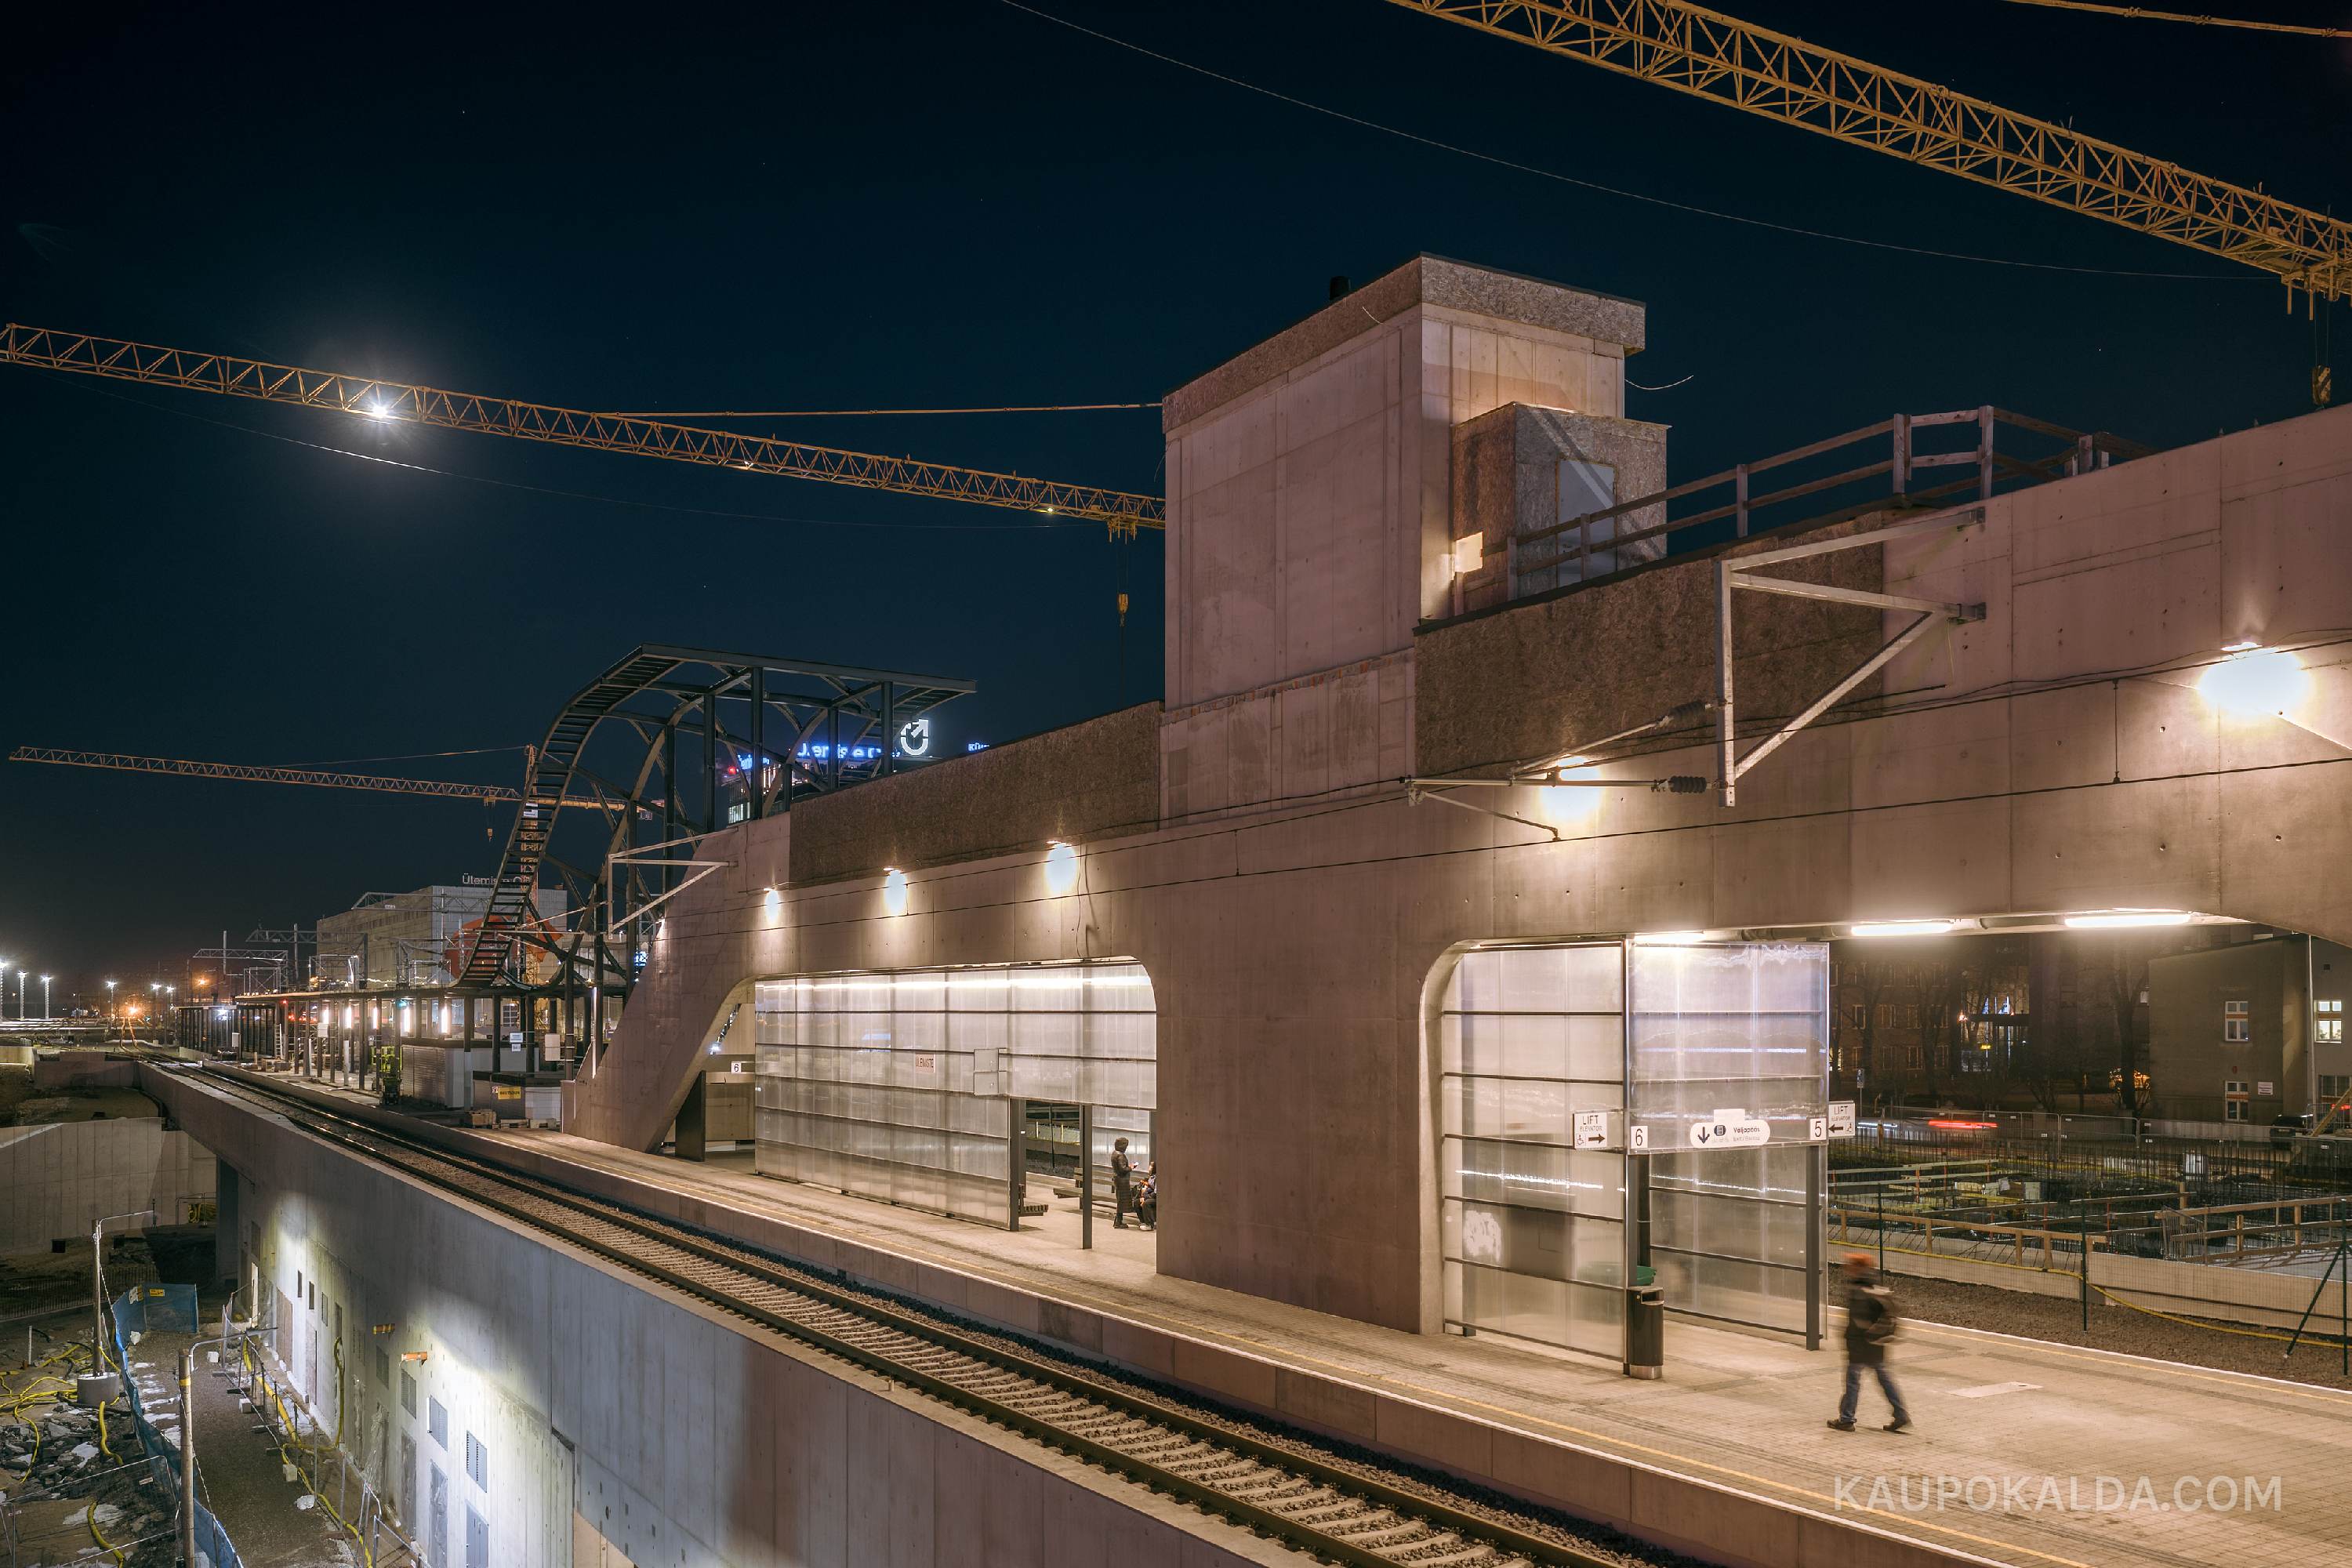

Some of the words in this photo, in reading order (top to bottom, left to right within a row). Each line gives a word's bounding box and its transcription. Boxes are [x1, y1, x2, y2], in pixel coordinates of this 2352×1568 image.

[734, 1063, 739, 1073] 6
[1835, 1105, 1848, 1114] LIFT
[1582, 1115, 1599, 1125] LIFT
[1814, 1120, 1822, 1137] 5
[1635, 1128, 1643, 1146] 6
